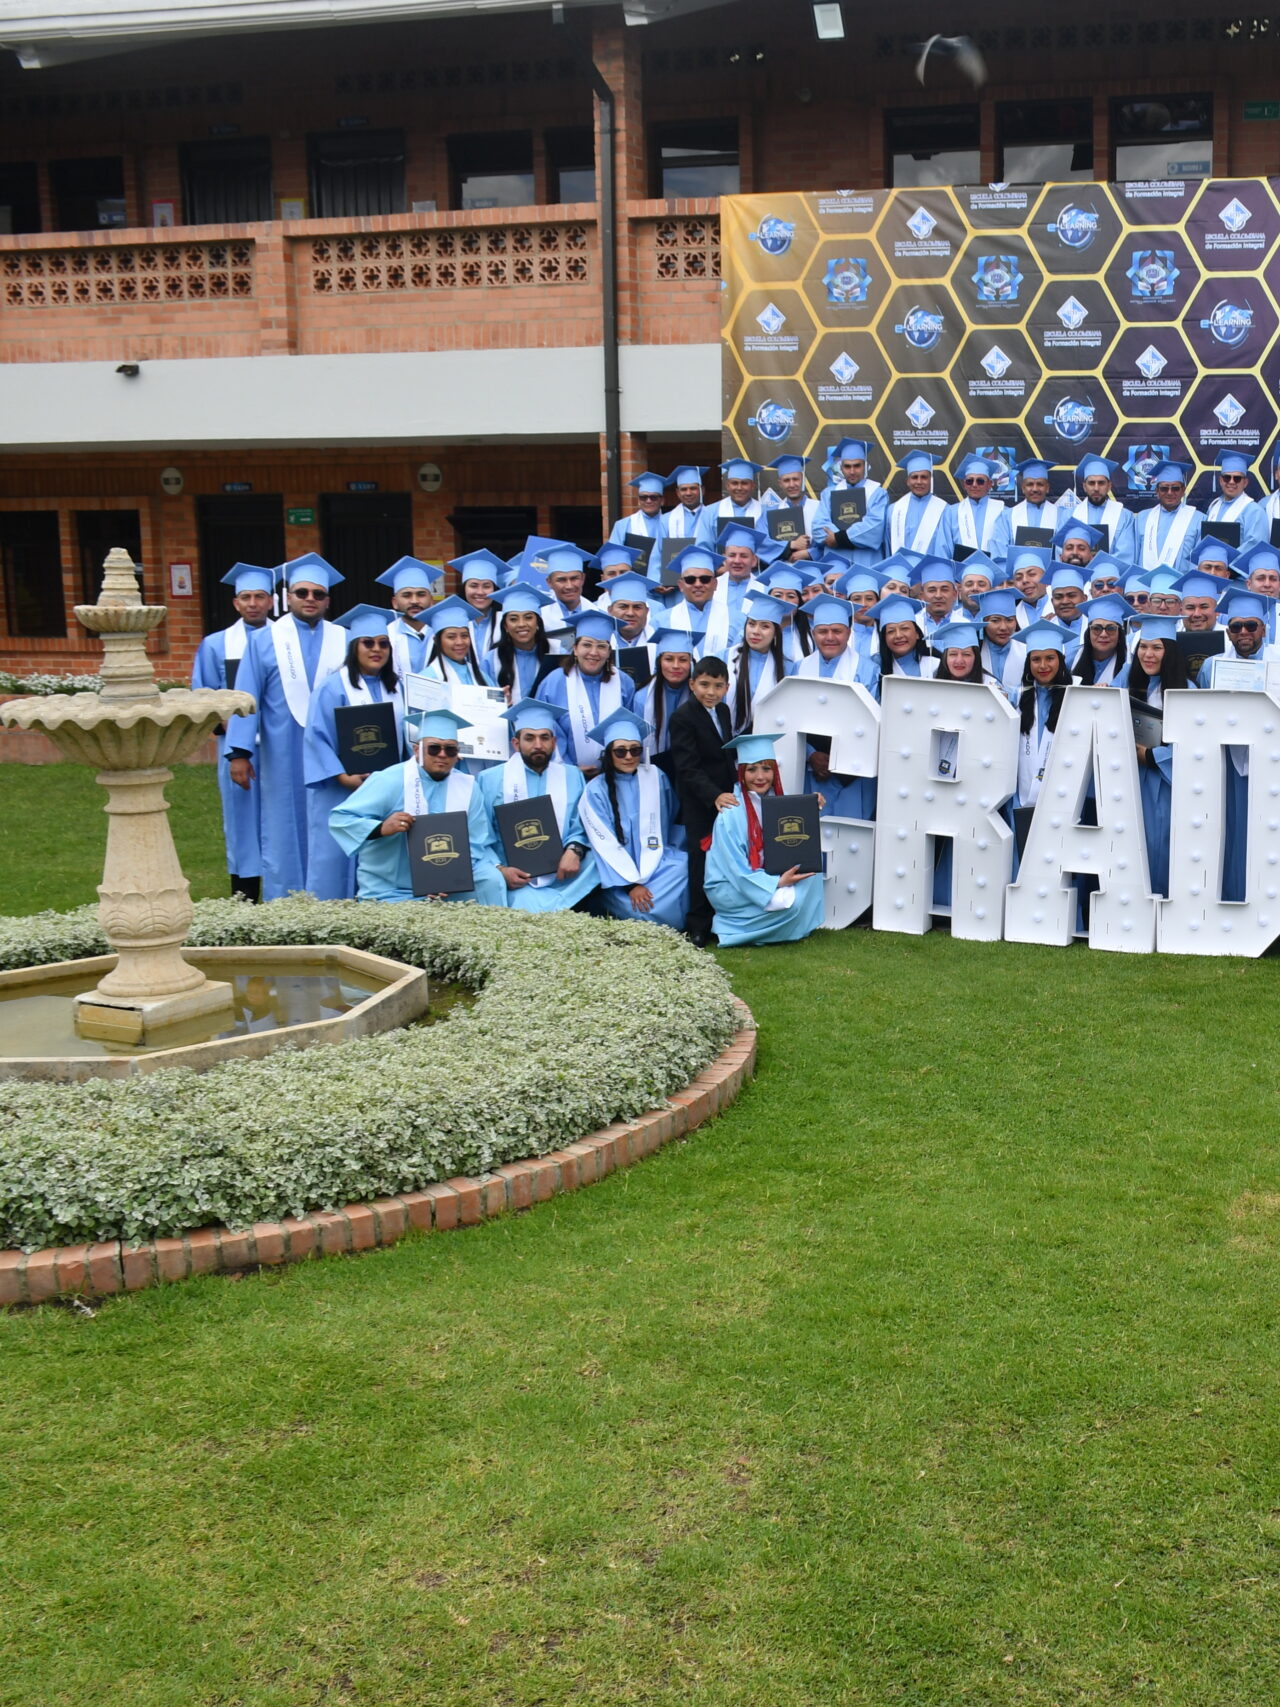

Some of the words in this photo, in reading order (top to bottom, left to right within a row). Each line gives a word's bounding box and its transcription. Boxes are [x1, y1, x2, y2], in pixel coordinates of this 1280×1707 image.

[1243, 242, 1264, 250] Integral
[1159, 389, 1180, 397] Integral
[1238, 438, 1259, 446] Integral
